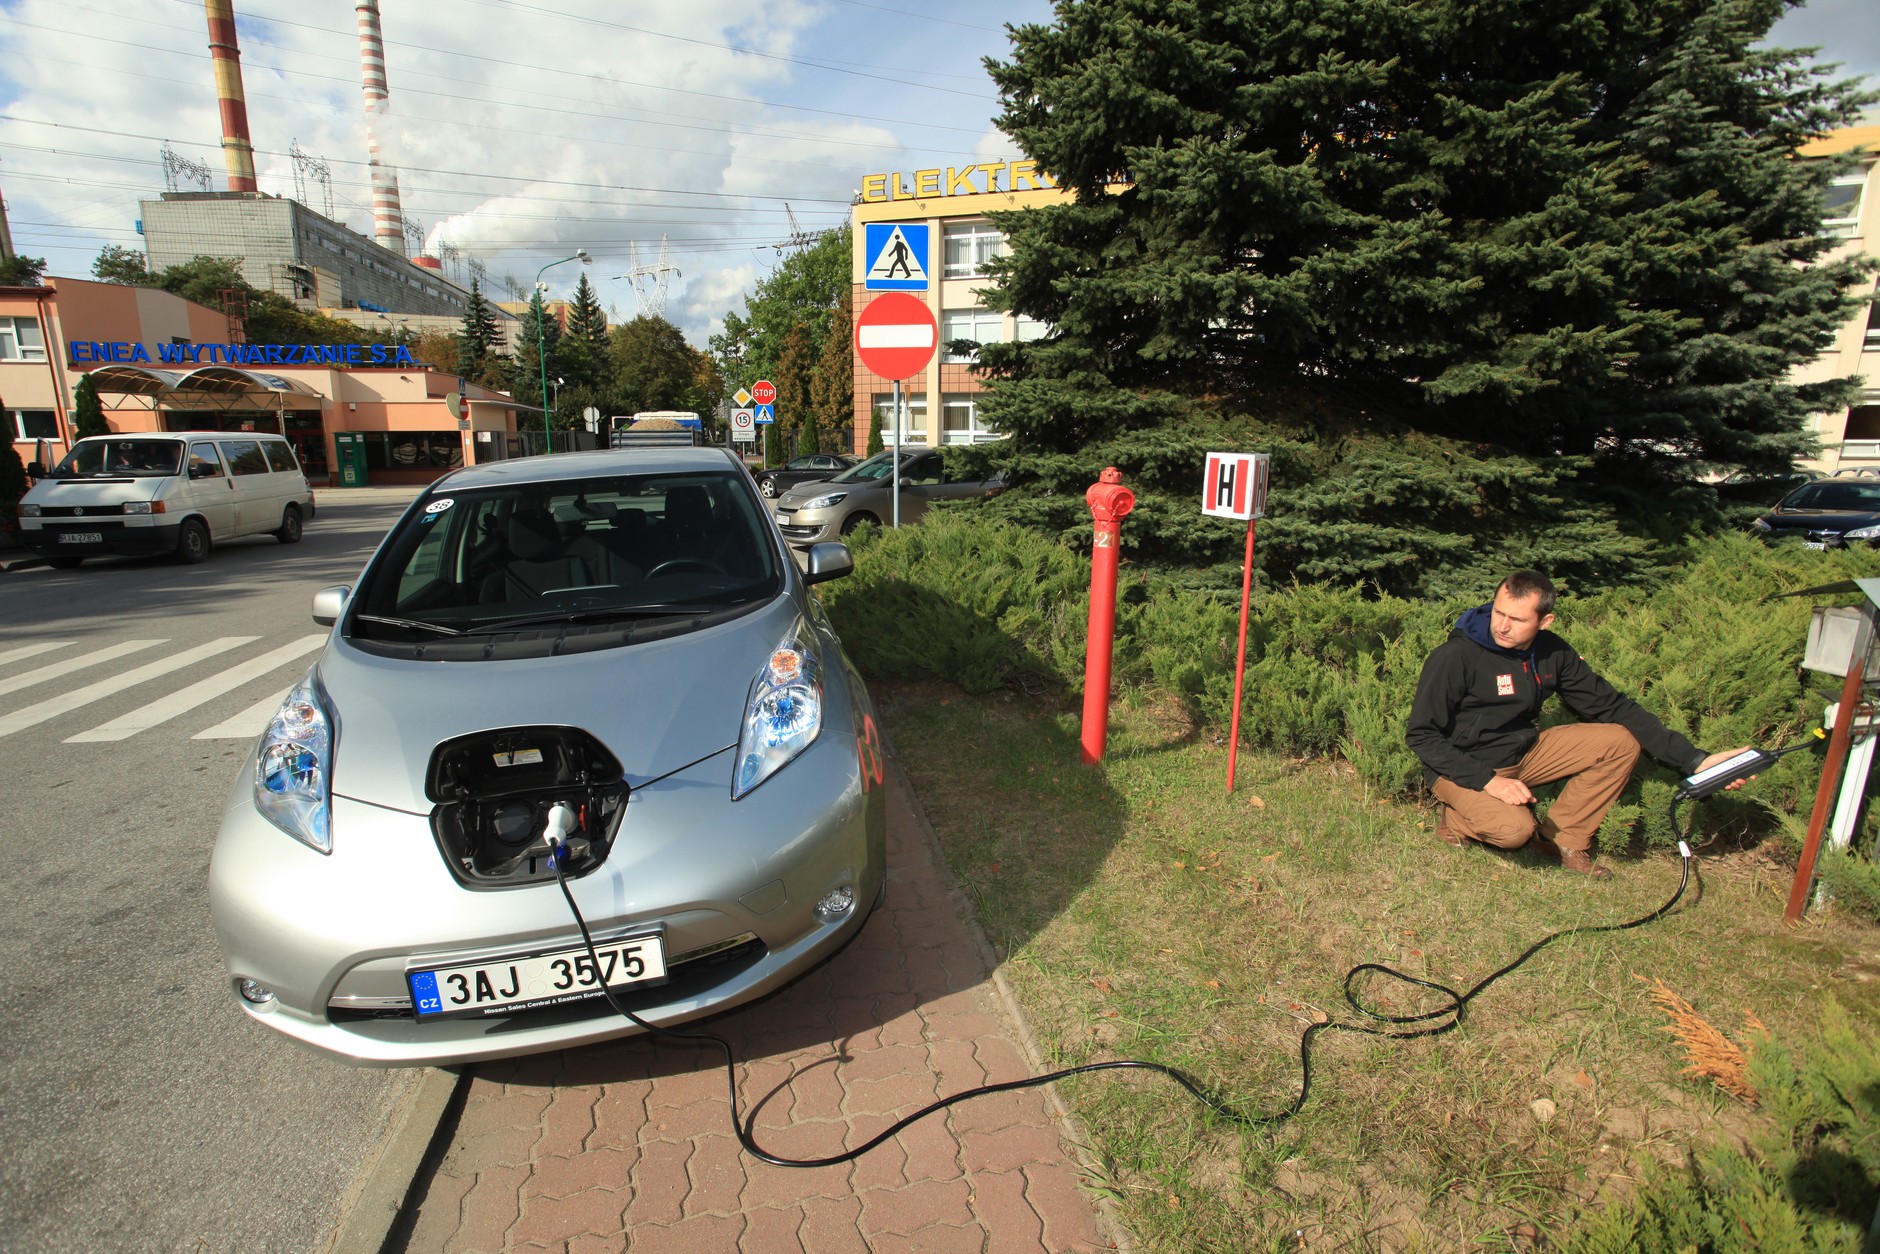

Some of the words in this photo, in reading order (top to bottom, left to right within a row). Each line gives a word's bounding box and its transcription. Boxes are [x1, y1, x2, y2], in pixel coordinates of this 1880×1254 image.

[862, 159, 1058, 203] ELEKTR
[70, 341, 151, 363] ENEA
[157, 343, 362, 364] WYTWARZANIE
[370, 344, 419, 364] S.A.
[754, 389, 774, 397] STOP
[739, 416, 748, 424] 15
[1217, 463, 1236, 507] H
[429, 501, 451, 511] 38
[446, 965, 520, 1005] 3AJ
[550, 945, 645, 990] 3575
[419, 997, 439, 1009] CZ
[484, 1006, 507, 1015] Nissan
[507, 1003, 526, 1011] Sales
[527, 999, 551, 1008] Central
[559, 995, 582, 1003] Eastern
